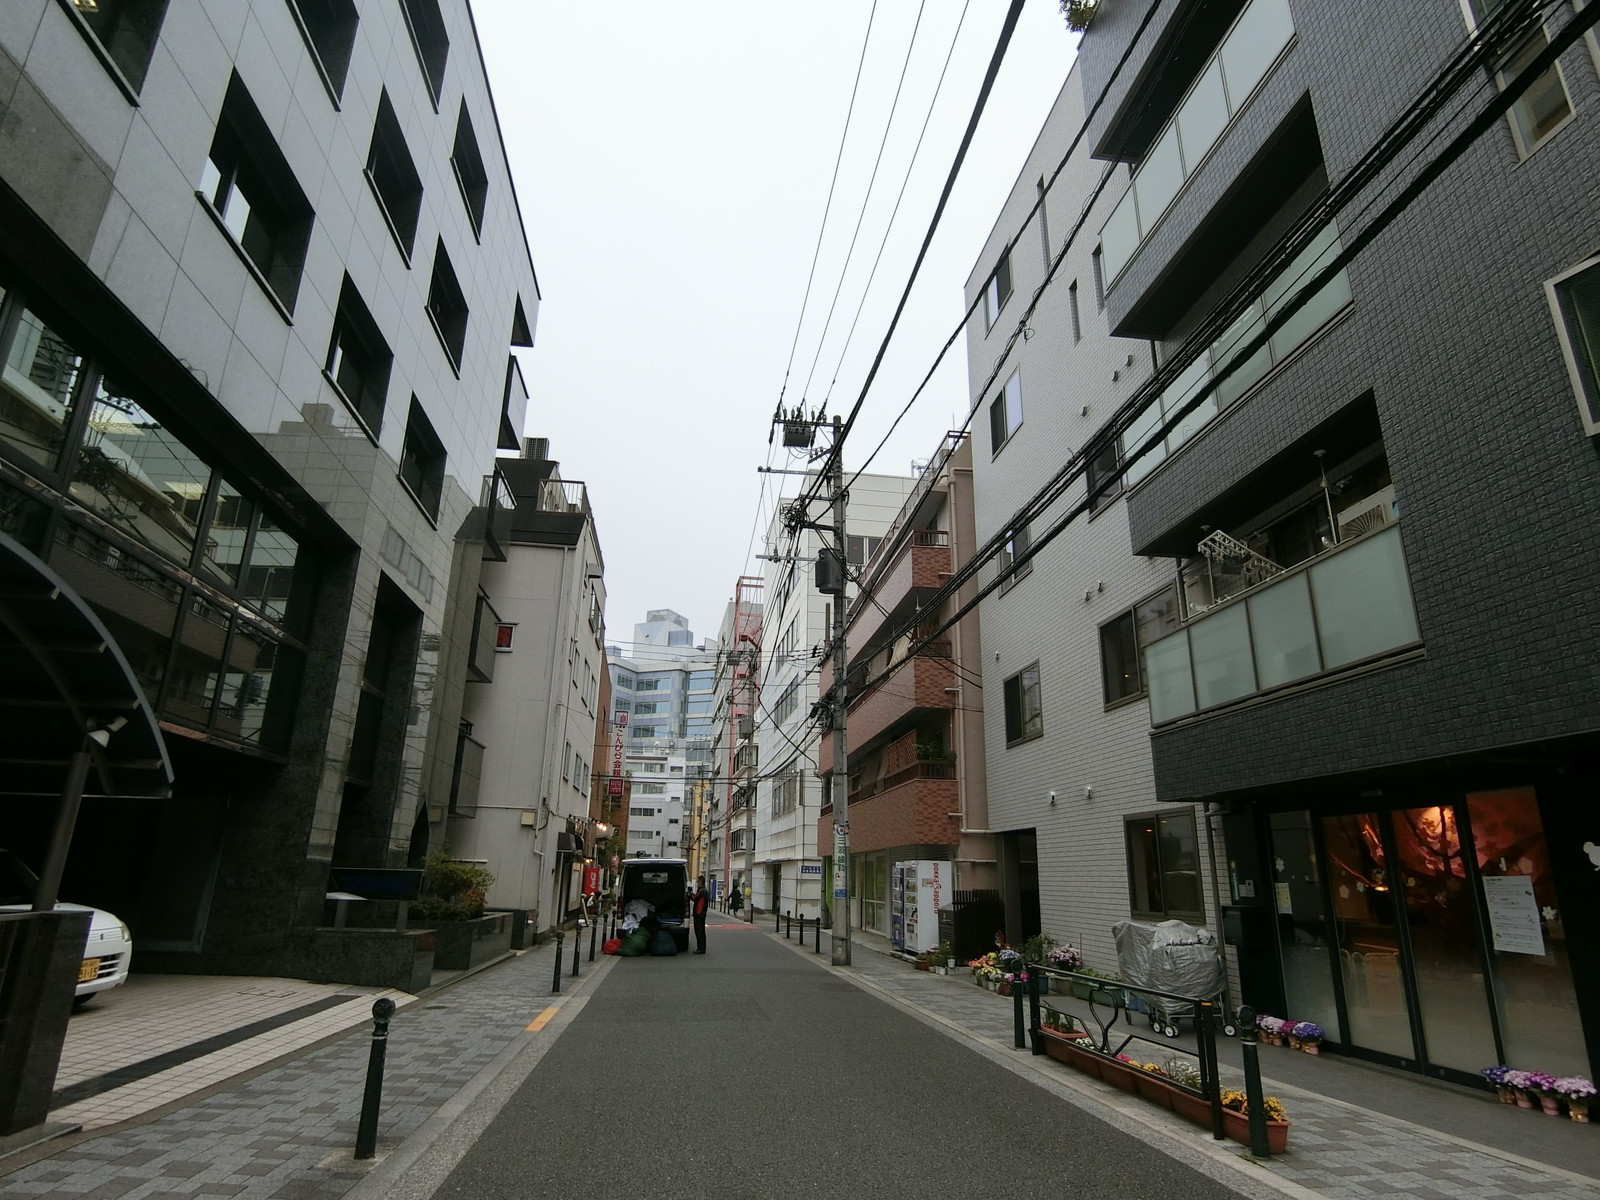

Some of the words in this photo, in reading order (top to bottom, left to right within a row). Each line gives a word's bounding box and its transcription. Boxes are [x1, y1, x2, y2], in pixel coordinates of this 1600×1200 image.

[612, 728, 624, 777] こんぴら会館
